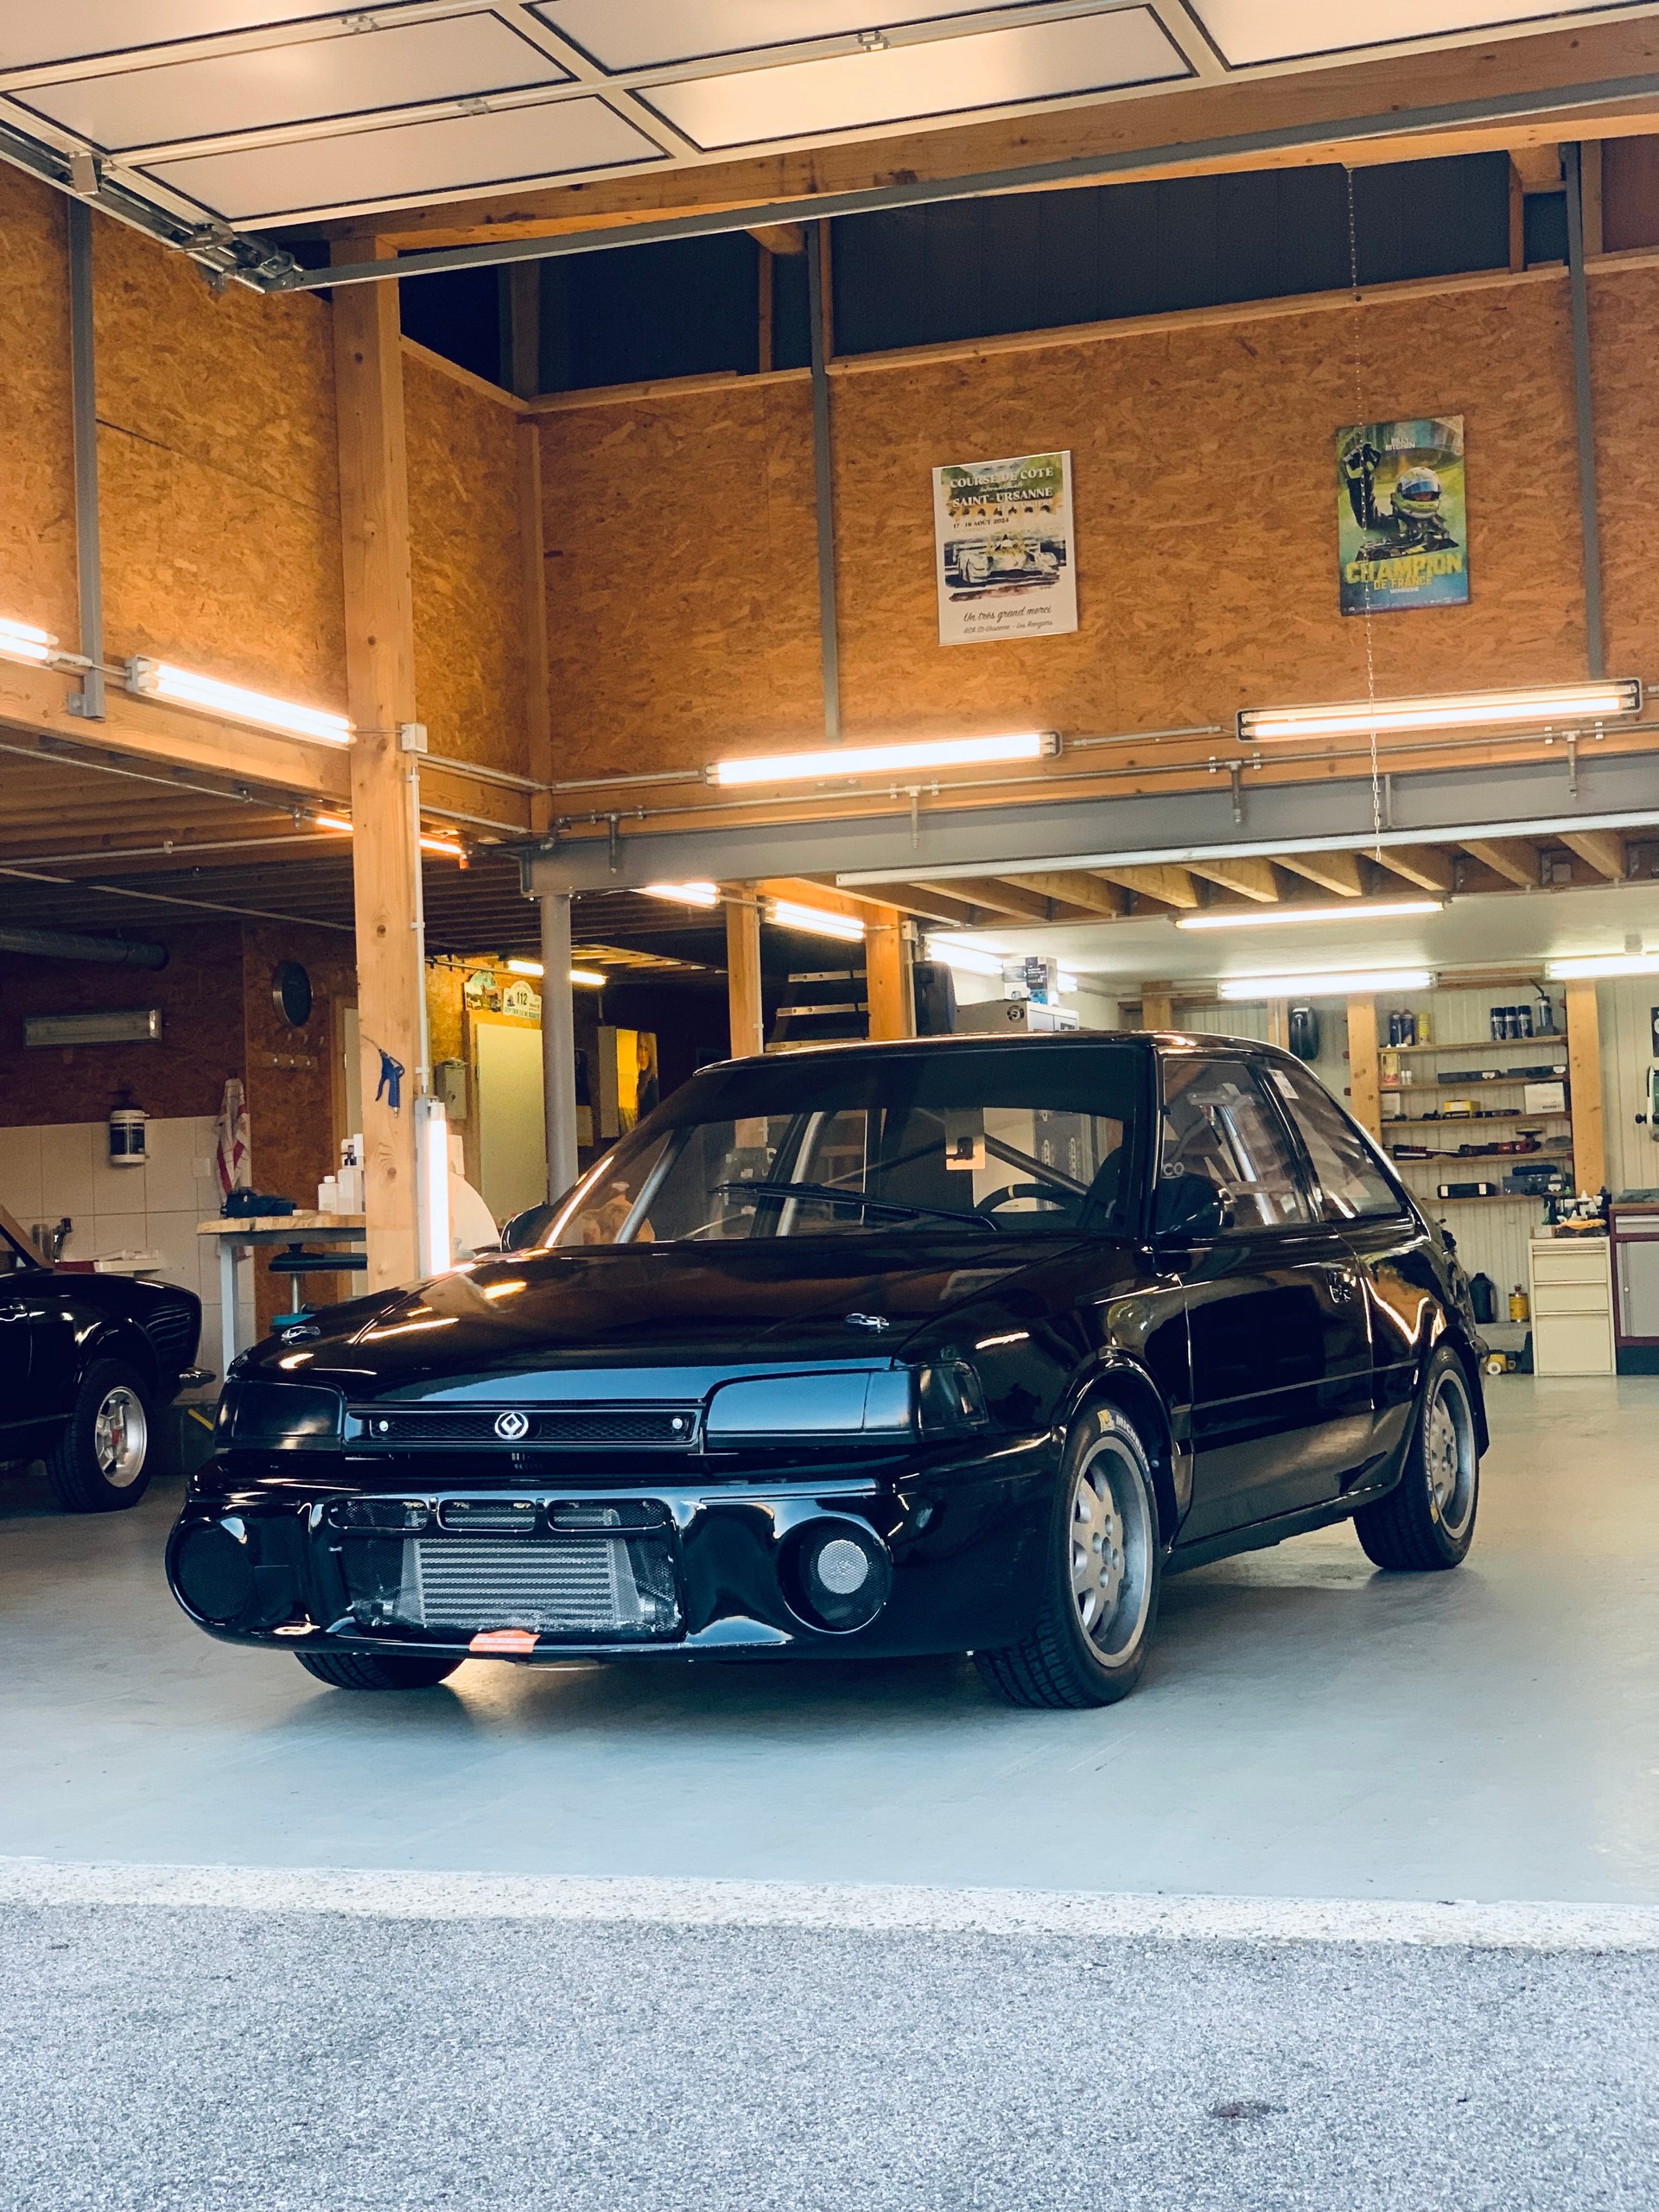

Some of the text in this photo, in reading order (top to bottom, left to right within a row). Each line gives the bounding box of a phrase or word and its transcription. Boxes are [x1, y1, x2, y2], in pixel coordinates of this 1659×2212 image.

[950, 474, 999, 488] COURSE
[1002, 473, 1017, 482] DE
[1345, 553, 1463, 584] CHAMPION
[1374, 580, 1387, 590] DE
[1391, 575, 1432, 588] FRANCE
[963, 612, 976, 622] Un
[996, 606, 1026, 623] grand
[1027, 605, 1052, 615] merci
[517, 991, 528, 1005] 112
